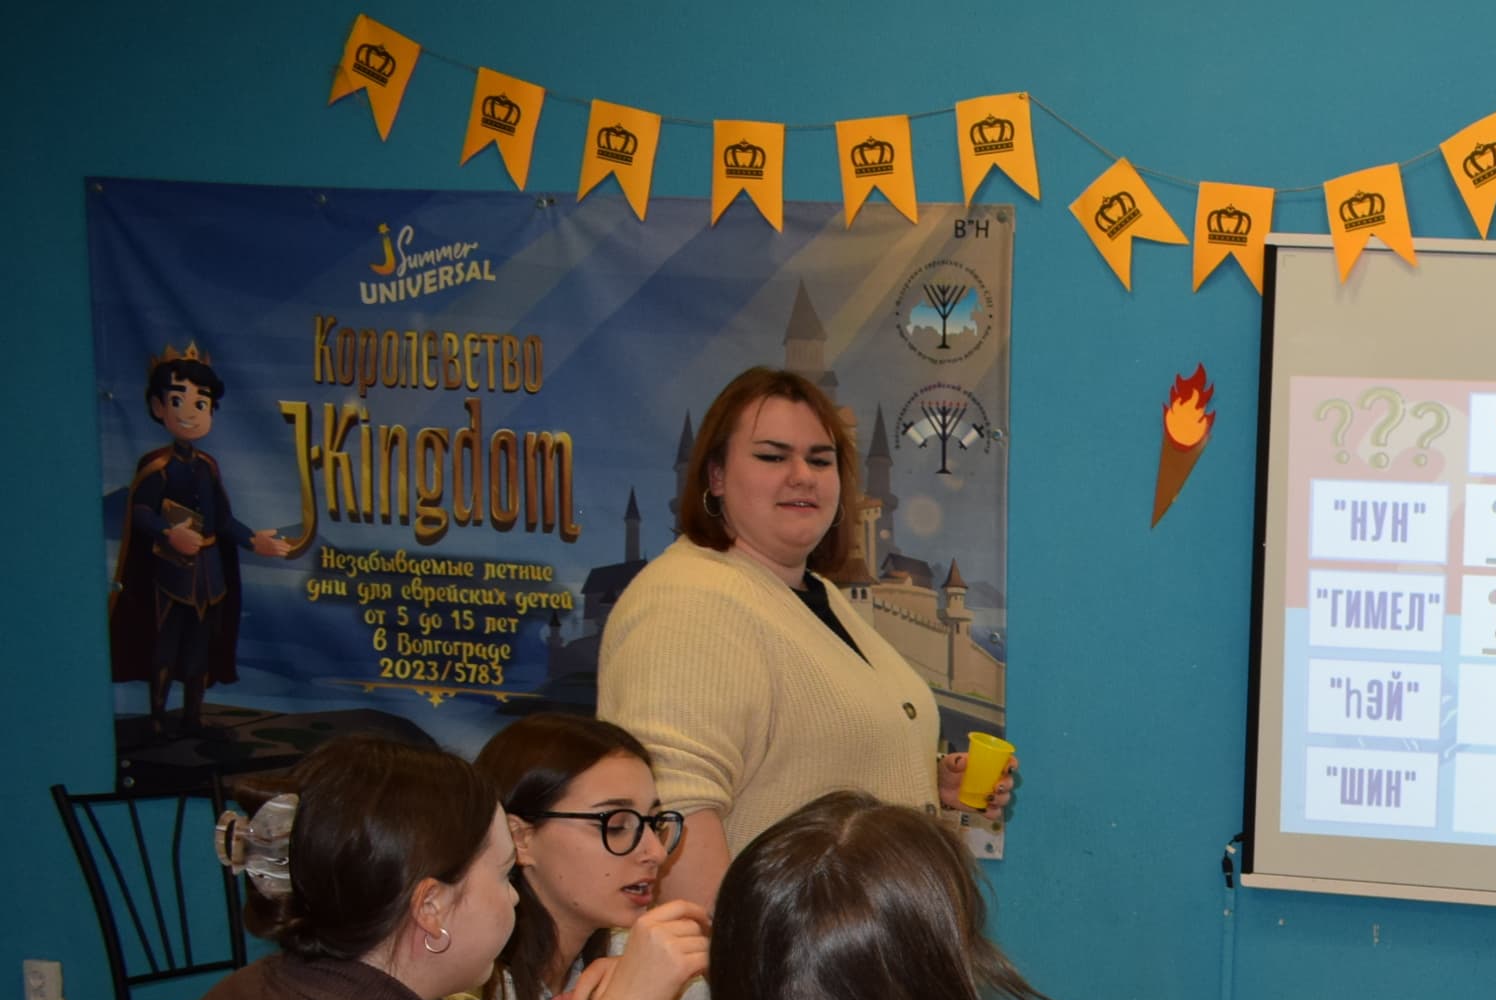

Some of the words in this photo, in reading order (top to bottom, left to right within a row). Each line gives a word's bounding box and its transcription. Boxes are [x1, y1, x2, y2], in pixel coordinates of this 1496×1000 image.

[359, 259, 497, 305] UNIVERSAL
[312, 313, 544, 398] Королевство
[1332, 498, 1426, 543] "НУН"
[321, 547, 475, 578] Незабываемые
[484, 561, 553, 582] летние
[307, 578, 347, 601] дни
[357, 582, 392, 604] для
[401, 577, 507, 608] еврейских
[515, 590, 574, 614] детей
[1316, 587, 1441, 633] "ГИМЕЛ"
[364, 608, 387, 625] от
[397, 606, 410, 627] 5
[419, 613, 442, 635] до
[451, 609, 475, 631] 15
[484, 614, 519, 634] лет
[397, 632, 512, 667] Волгограде
[379, 657, 505, 686] 2023/5783
[1326, 766, 1417, 809] "ШИН"
